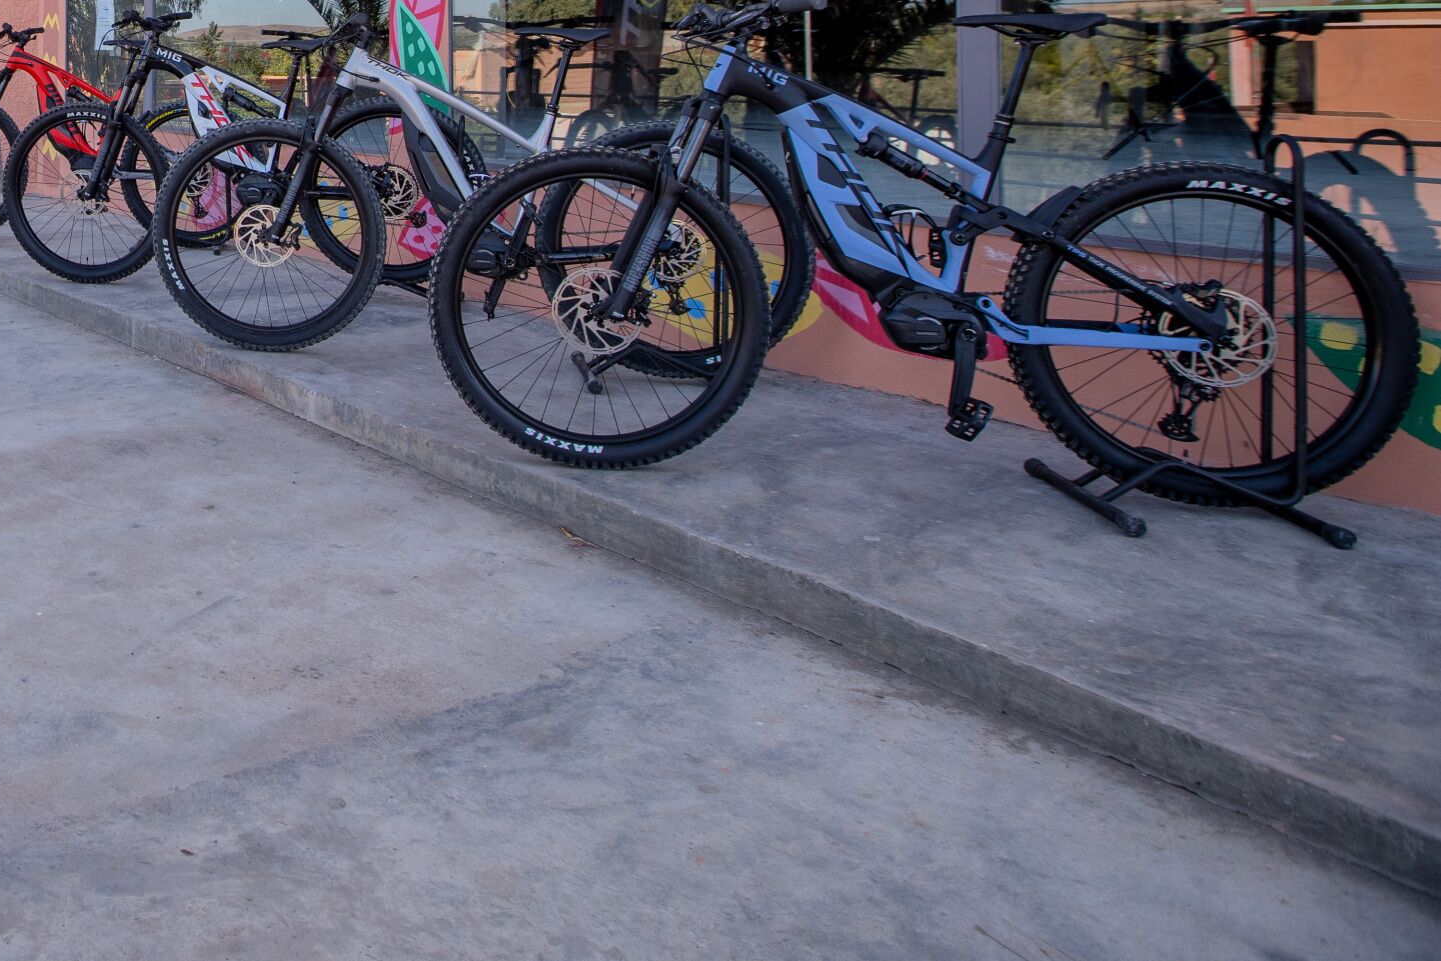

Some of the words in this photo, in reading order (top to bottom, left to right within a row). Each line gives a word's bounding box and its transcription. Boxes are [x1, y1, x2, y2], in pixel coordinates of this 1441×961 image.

[156, 47, 183, 64] MIG
[66, 111, 107, 120] MAXXIS
[1186, 180, 1293, 206] MAXXIS
[162, 238, 186, 290] MAXXIS
[524, 427, 604, 454] MAXXIS
